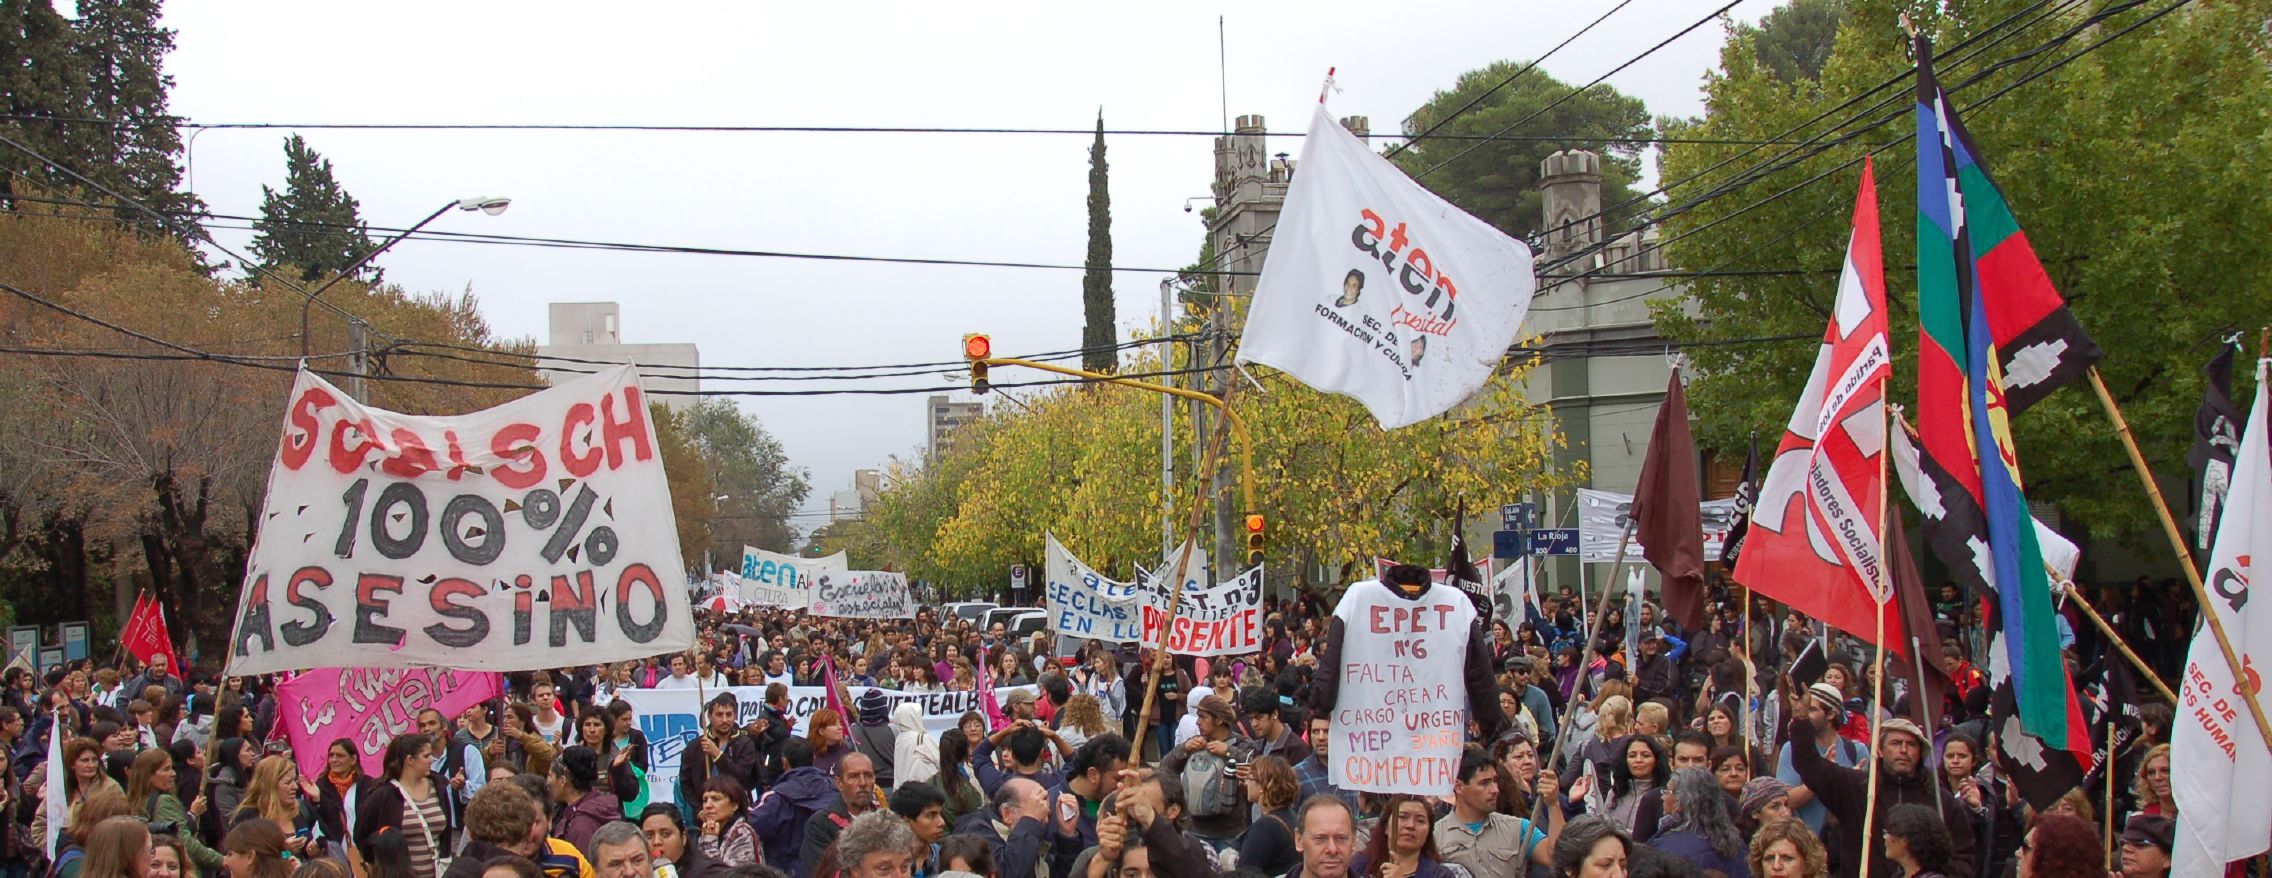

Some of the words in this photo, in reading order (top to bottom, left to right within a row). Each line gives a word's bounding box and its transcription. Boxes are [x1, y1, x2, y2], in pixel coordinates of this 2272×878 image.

[1352, 208, 1457, 322] aten
[1363, 314, 1382, 334] SEC.
[334, 478, 619, 566] 100%
[1538, 532, 1547, 540] La
[1549, 531, 1568, 541] Rioja
[742, 553, 798, 589] aten
[1059, 610, 1093, 634] EN
[1346, 663, 1415, 684] FALTA
[1384, 684, 1448, 706] CREAR
[2189, 661, 2213, 699] SEC.
[2212, 698, 2237, 724] DE
[1339, 708, 1395, 727] CARGO
[1348, 730, 1393, 753] MEP
